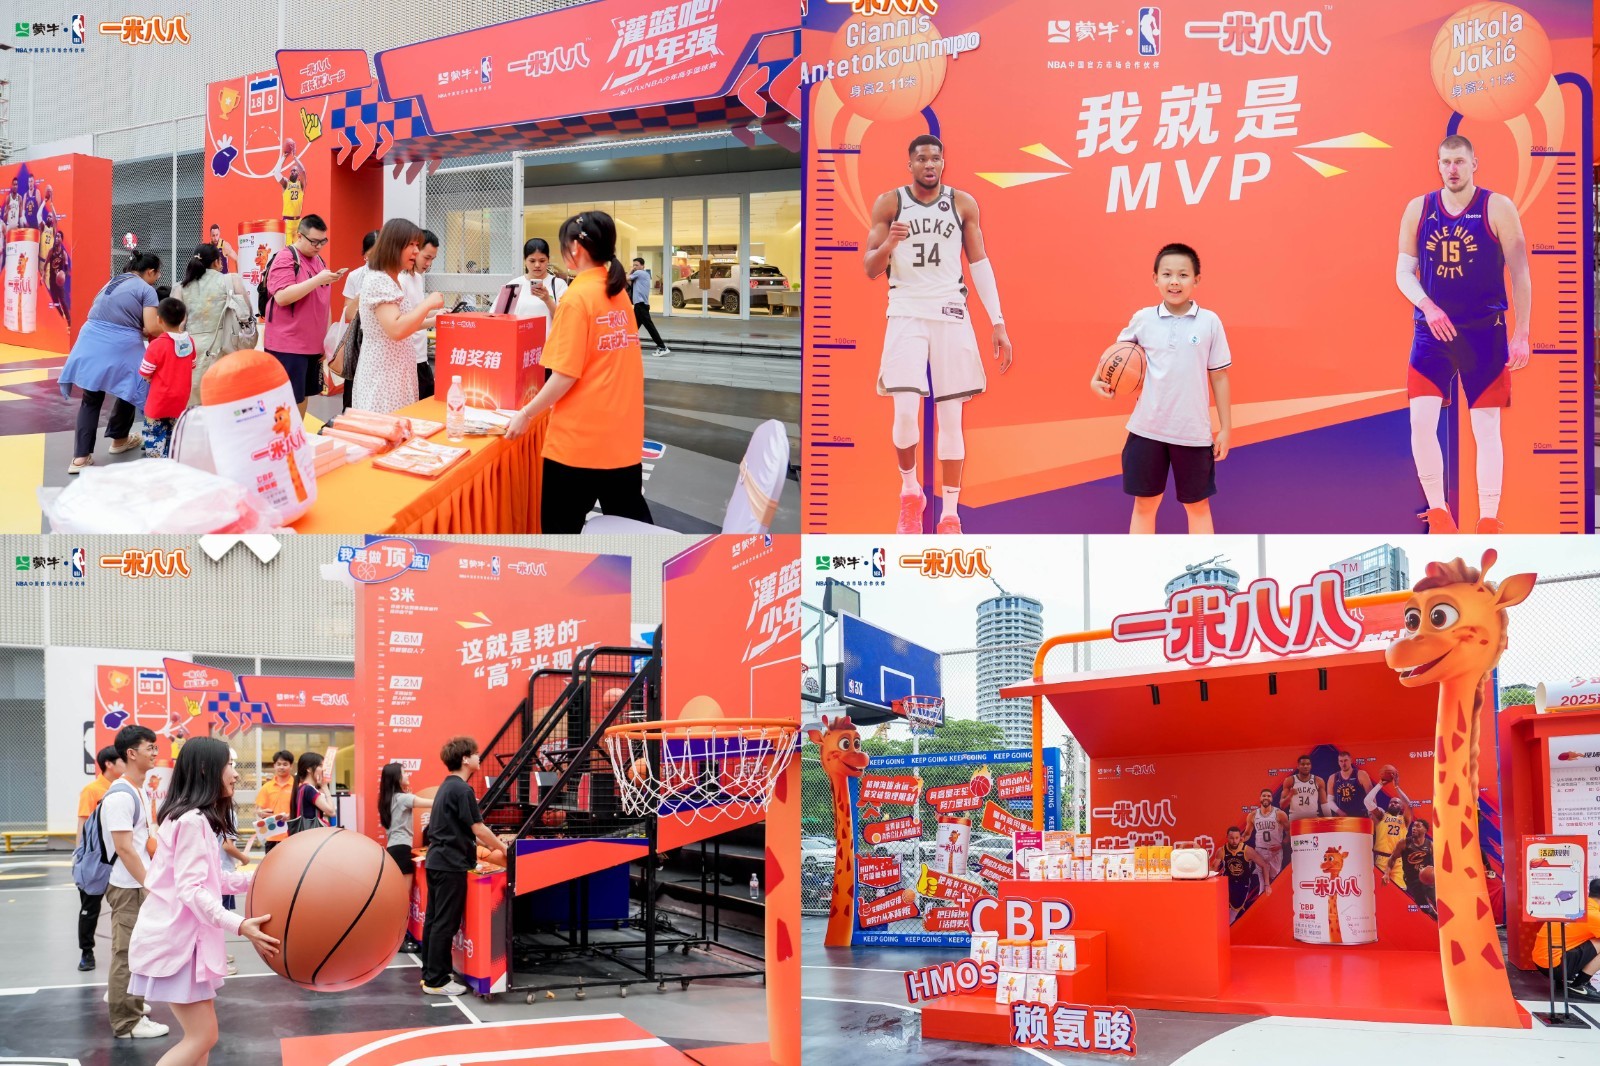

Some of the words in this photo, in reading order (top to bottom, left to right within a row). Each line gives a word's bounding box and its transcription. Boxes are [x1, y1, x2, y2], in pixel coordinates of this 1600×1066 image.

[846, 15, 930, 48] Giannis
[1075, 21, 1119, 42] 蒙牛
[1185, 11, 1331, 55] 一米八八
[1453, 12, 1523, 48] Nikola
[610, 24, 720, 89] 少年强
[801, 32, 980, 85] Antetokounmpo
[1142, 44, 1152, 53] NBA
[1452, 38, 1516, 77] Jokić
[300, 58, 331, 76] 一米八八
[508, 42, 590, 77] 一米八八
[1047, 61, 1160, 69] NBA中国官方市场合作伙伴
[849, 75, 917, 98] 身高2.11米
[1450, 72, 1515, 99] 身高2.11米
[251, 97, 262, 108] 18
[268, 95, 273, 105] 8
[1075, 75, 1302, 158] 我就是
[1106, 152, 1271, 213] MVP
[291, 191, 299, 200] 23
[906, 218, 955, 239] UCKS
[1426, 226, 1450, 251] MILE
[1454, 226, 1478, 252] HIGH
[912, 243, 941, 267] 34
[1442, 241, 1460, 262] 15
[1436, 265, 1463, 279] CITY
[450, 347, 502, 369] 抽奖箱
[508, 562, 547, 576] 一米八八
[1342, 563, 1358, 572] TM
[390, 587, 414, 602] 3米
[1112, 570, 1363, 665] 一米八八
[394, 634, 419, 643] 2.6M
[458, 619, 584, 665] 这就是我的
[393, 679, 418, 687] 2.2M
[855, 681, 863, 696] 3X
[312, 694, 349, 706] 一米八八
[393, 717, 419, 725] 1.88M
[1125, 764, 1155, 775] 一米八八
[1296, 787, 1315, 795] UCKS
[1298, 796, 1310, 806] 34
[1342, 788, 1350, 796] 15
[1093, 799, 1176, 828] 一米八八
[1262, 830, 1271, 842] 0
[1388, 825, 1399, 835] 23
[1300, 876, 1361, 897] 一米八八
[971, 899, 1072, 941] CBP
[908, 962, 998, 1000] HMOs
[1014, 1004, 1131, 1052] 赖氨酸
